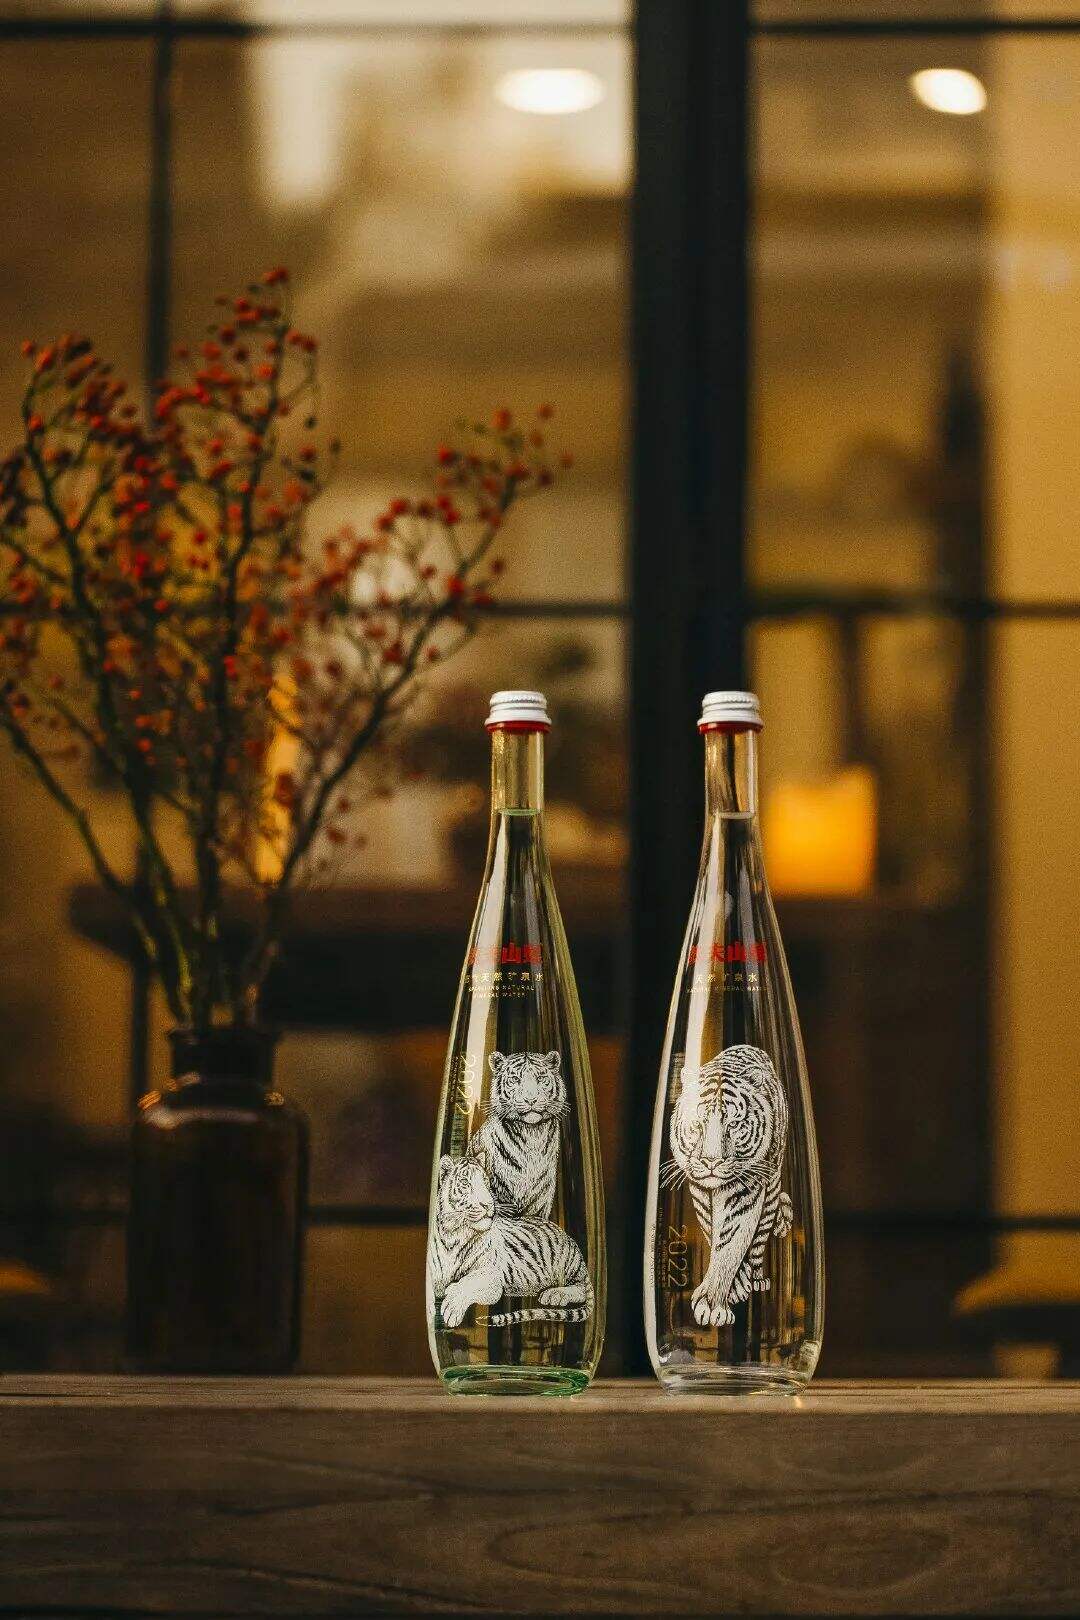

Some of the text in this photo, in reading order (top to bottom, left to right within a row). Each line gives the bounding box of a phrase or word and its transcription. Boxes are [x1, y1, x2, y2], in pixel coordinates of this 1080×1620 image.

[468, 942, 542, 965] 山泉
[688, 941, 767, 966] 夫山泉
[464, 971, 544, 984] 天然矿泉水
[455, 1055, 476, 1115] 2022
[668, 1225, 688, 1288] 2022
